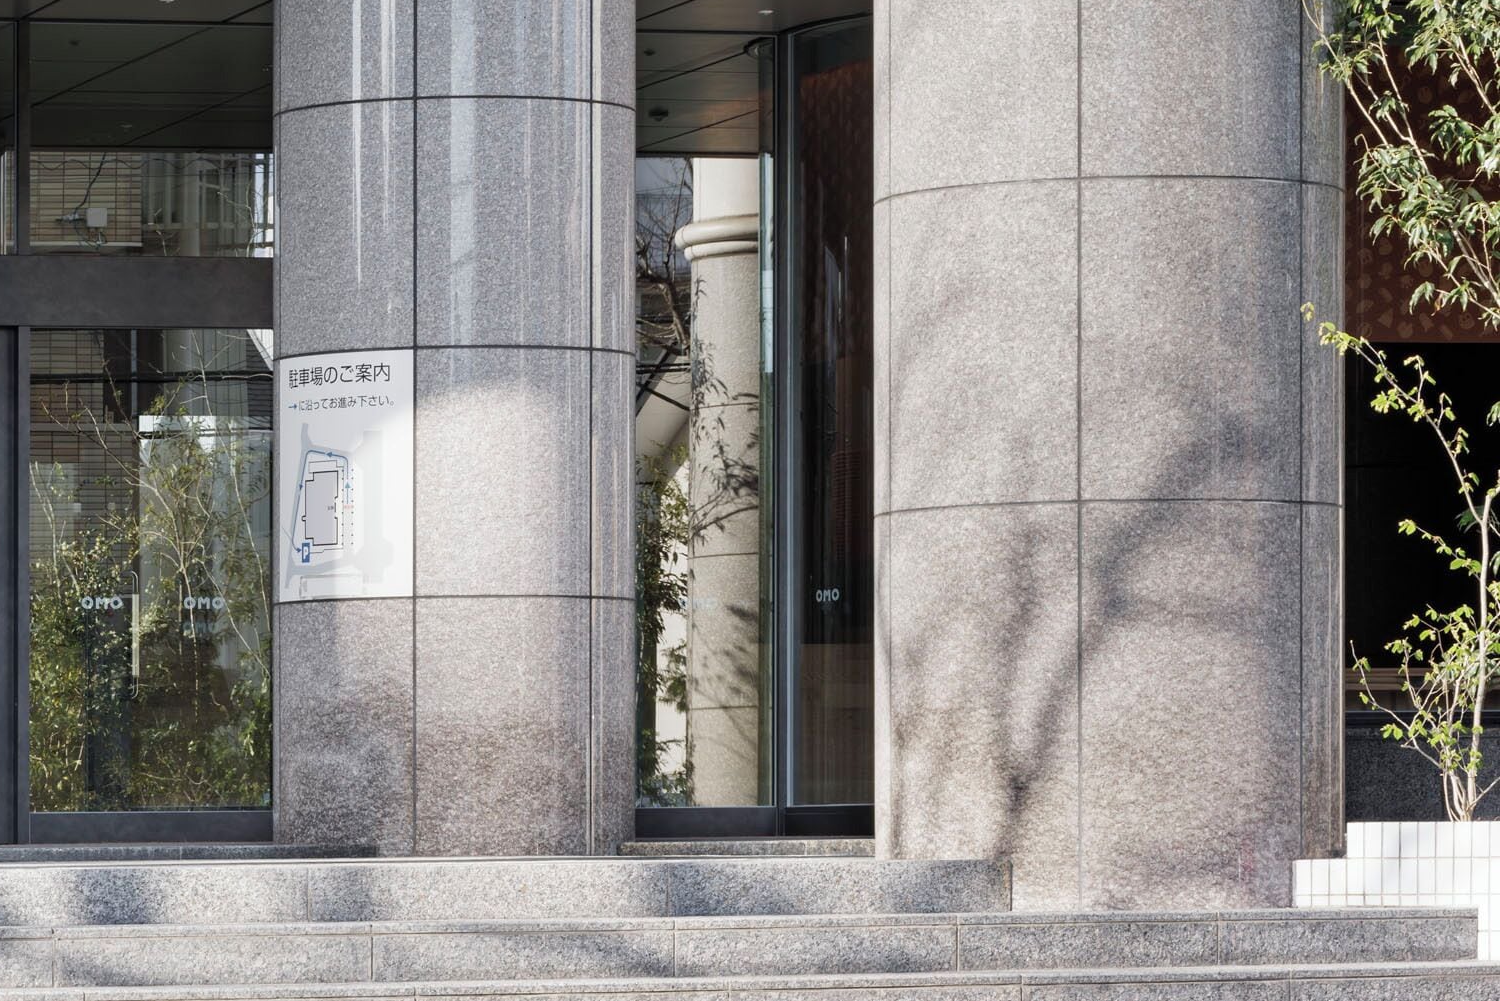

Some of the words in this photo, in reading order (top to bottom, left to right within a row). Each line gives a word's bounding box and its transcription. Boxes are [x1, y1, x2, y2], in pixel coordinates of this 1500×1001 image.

[288, 363, 391, 389] 駐車場のご案内
[816, 588, 840, 602] OMO
[81, 596, 124, 610] OMO
[184, 596, 225, 610] OMO
